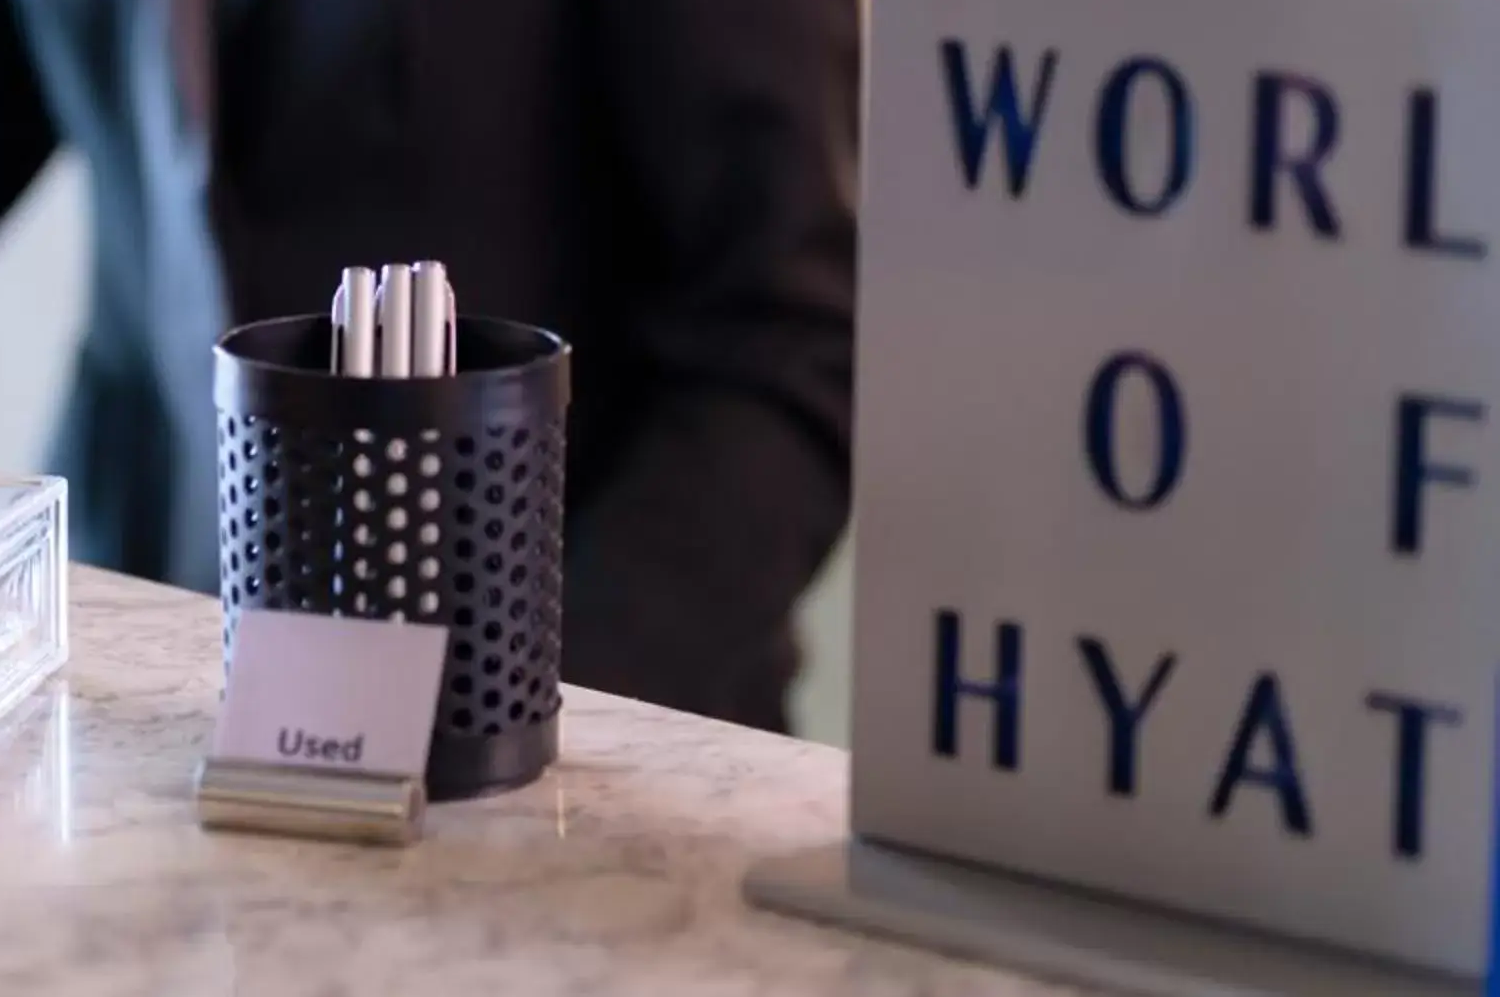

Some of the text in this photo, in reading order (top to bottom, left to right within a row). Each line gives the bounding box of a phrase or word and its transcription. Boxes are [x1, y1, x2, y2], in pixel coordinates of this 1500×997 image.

[939, 37, 1487, 259] WORL
[277, 728, 364, 763] Used
[932, 609, 1462, 860] HYAT
